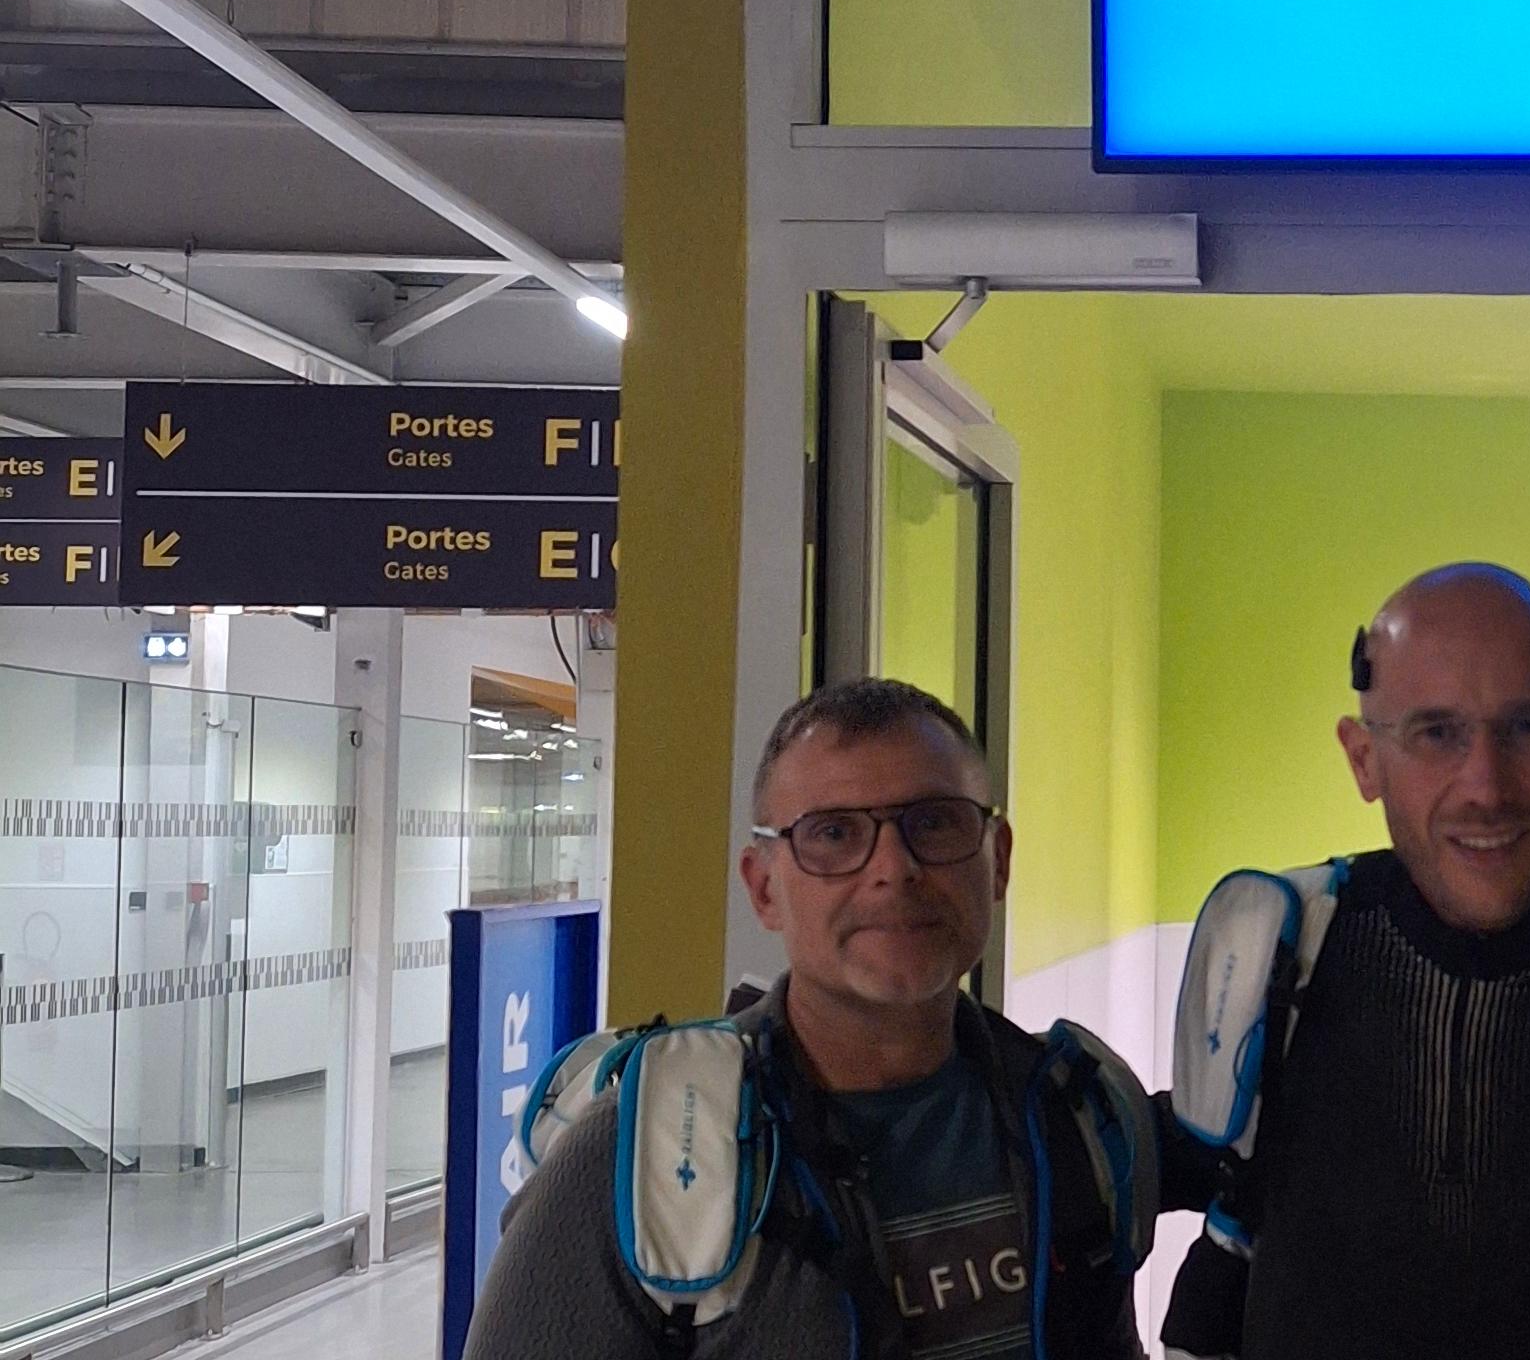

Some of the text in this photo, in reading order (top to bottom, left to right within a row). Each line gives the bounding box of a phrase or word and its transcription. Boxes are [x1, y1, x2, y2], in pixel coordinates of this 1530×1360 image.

[389, 412, 494, 438] Portes
[544, 418, 582, 466] F
[388, 448, 453, 467] Gates
[385, 525, 491, 551] Portes
[540, 531, 579, 579] E
[383, 561, 449, 580] Gates
